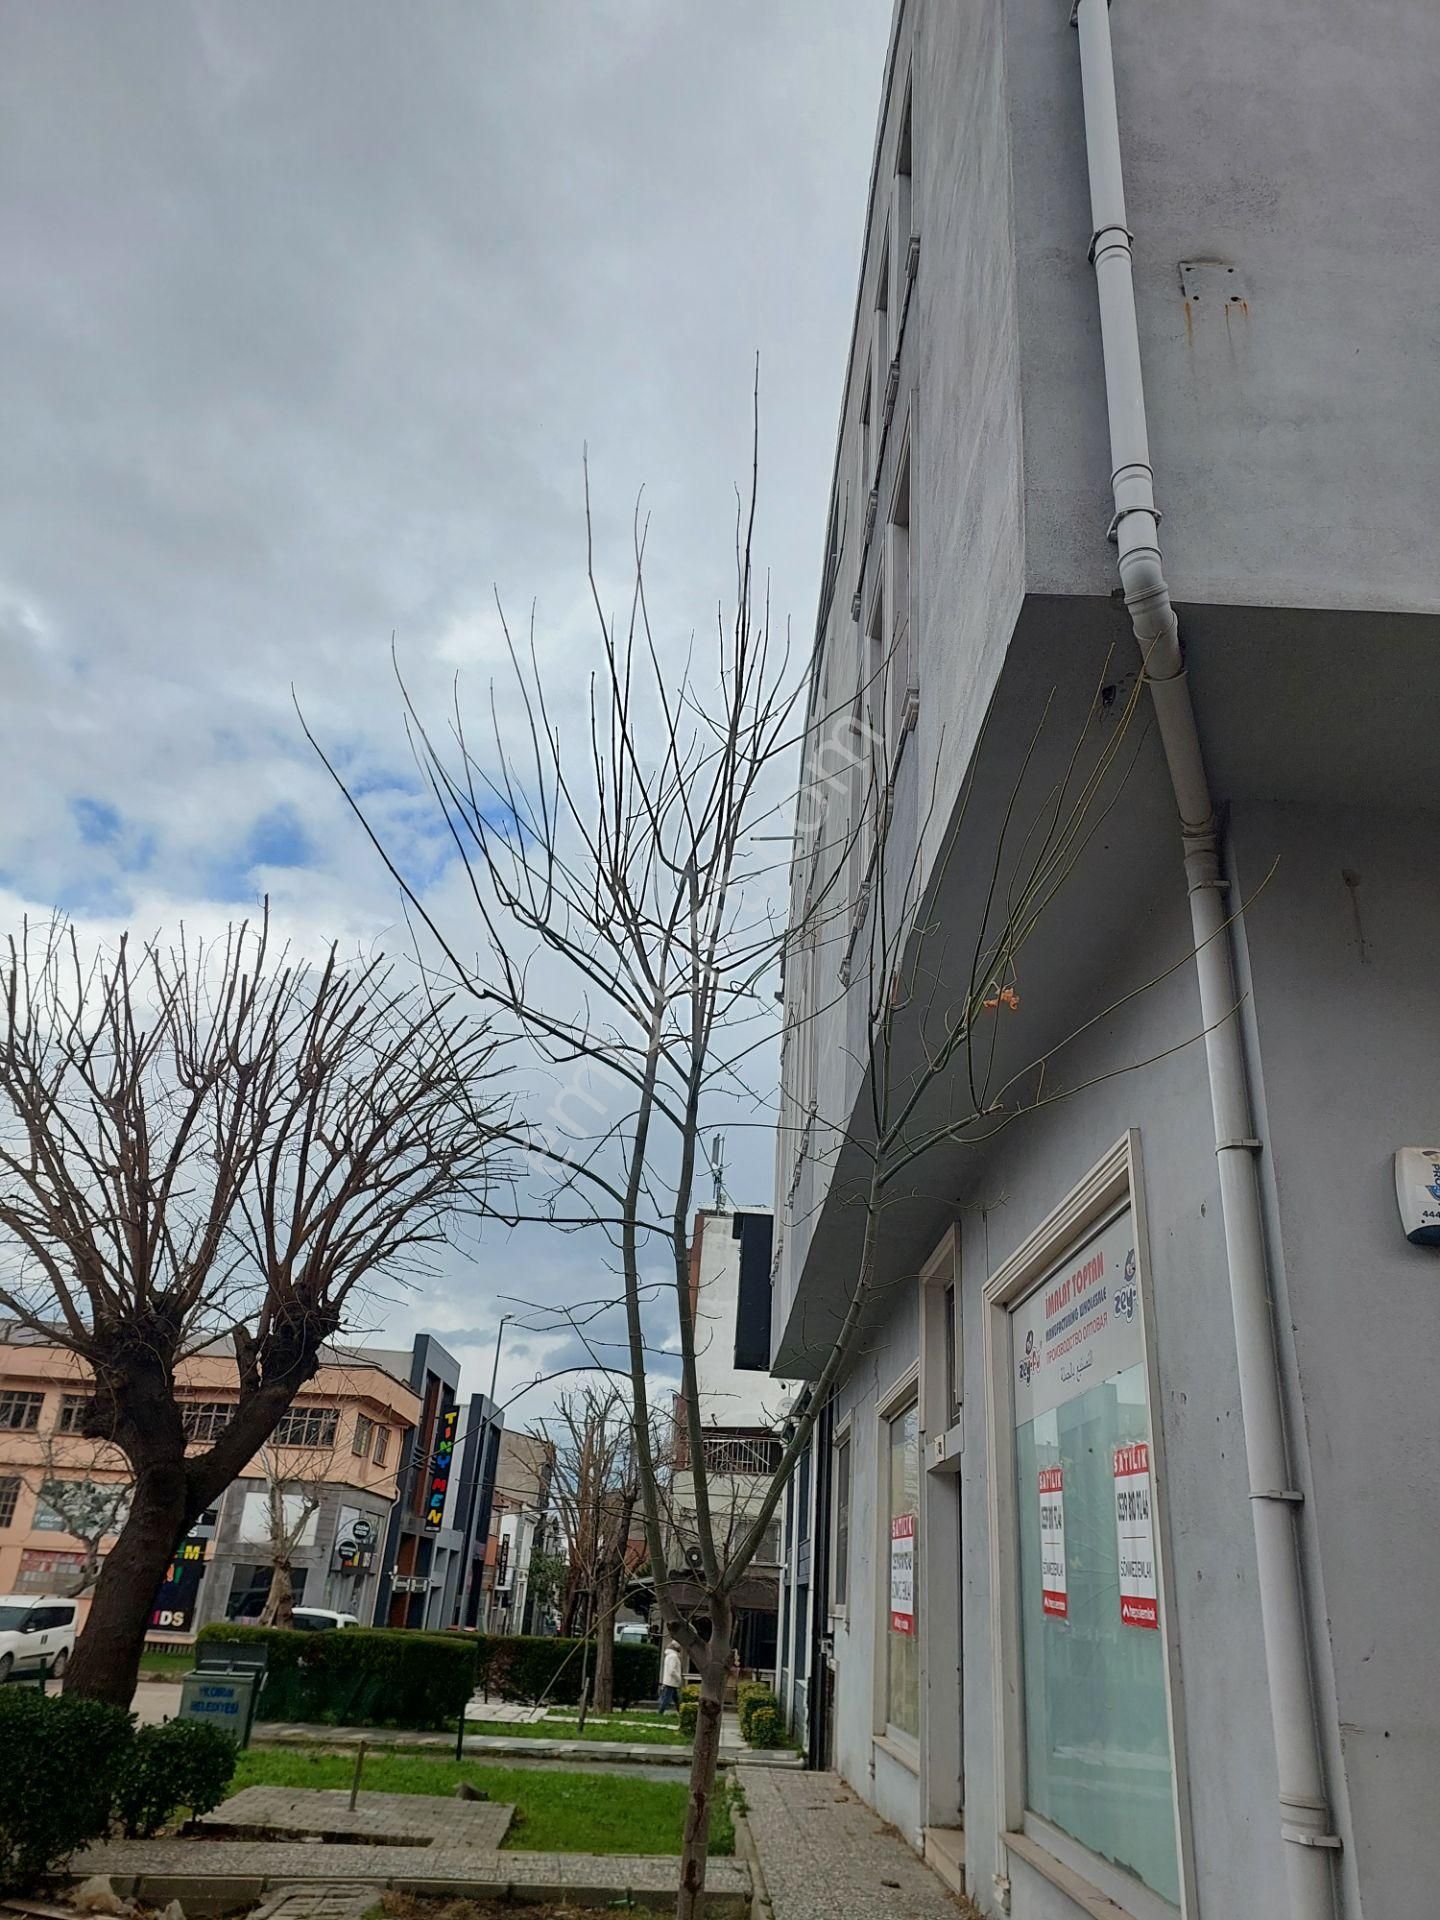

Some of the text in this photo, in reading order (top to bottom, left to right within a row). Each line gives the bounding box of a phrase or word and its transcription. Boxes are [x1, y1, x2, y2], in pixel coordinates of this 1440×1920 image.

[1072, 1251, 1105, 1297] TOPTAN
[437, 1411, 457, 1468] TINY
[1114, 1447, 1148, 1473] SATILIK
[427, 1478, 447, 1524] MEN
